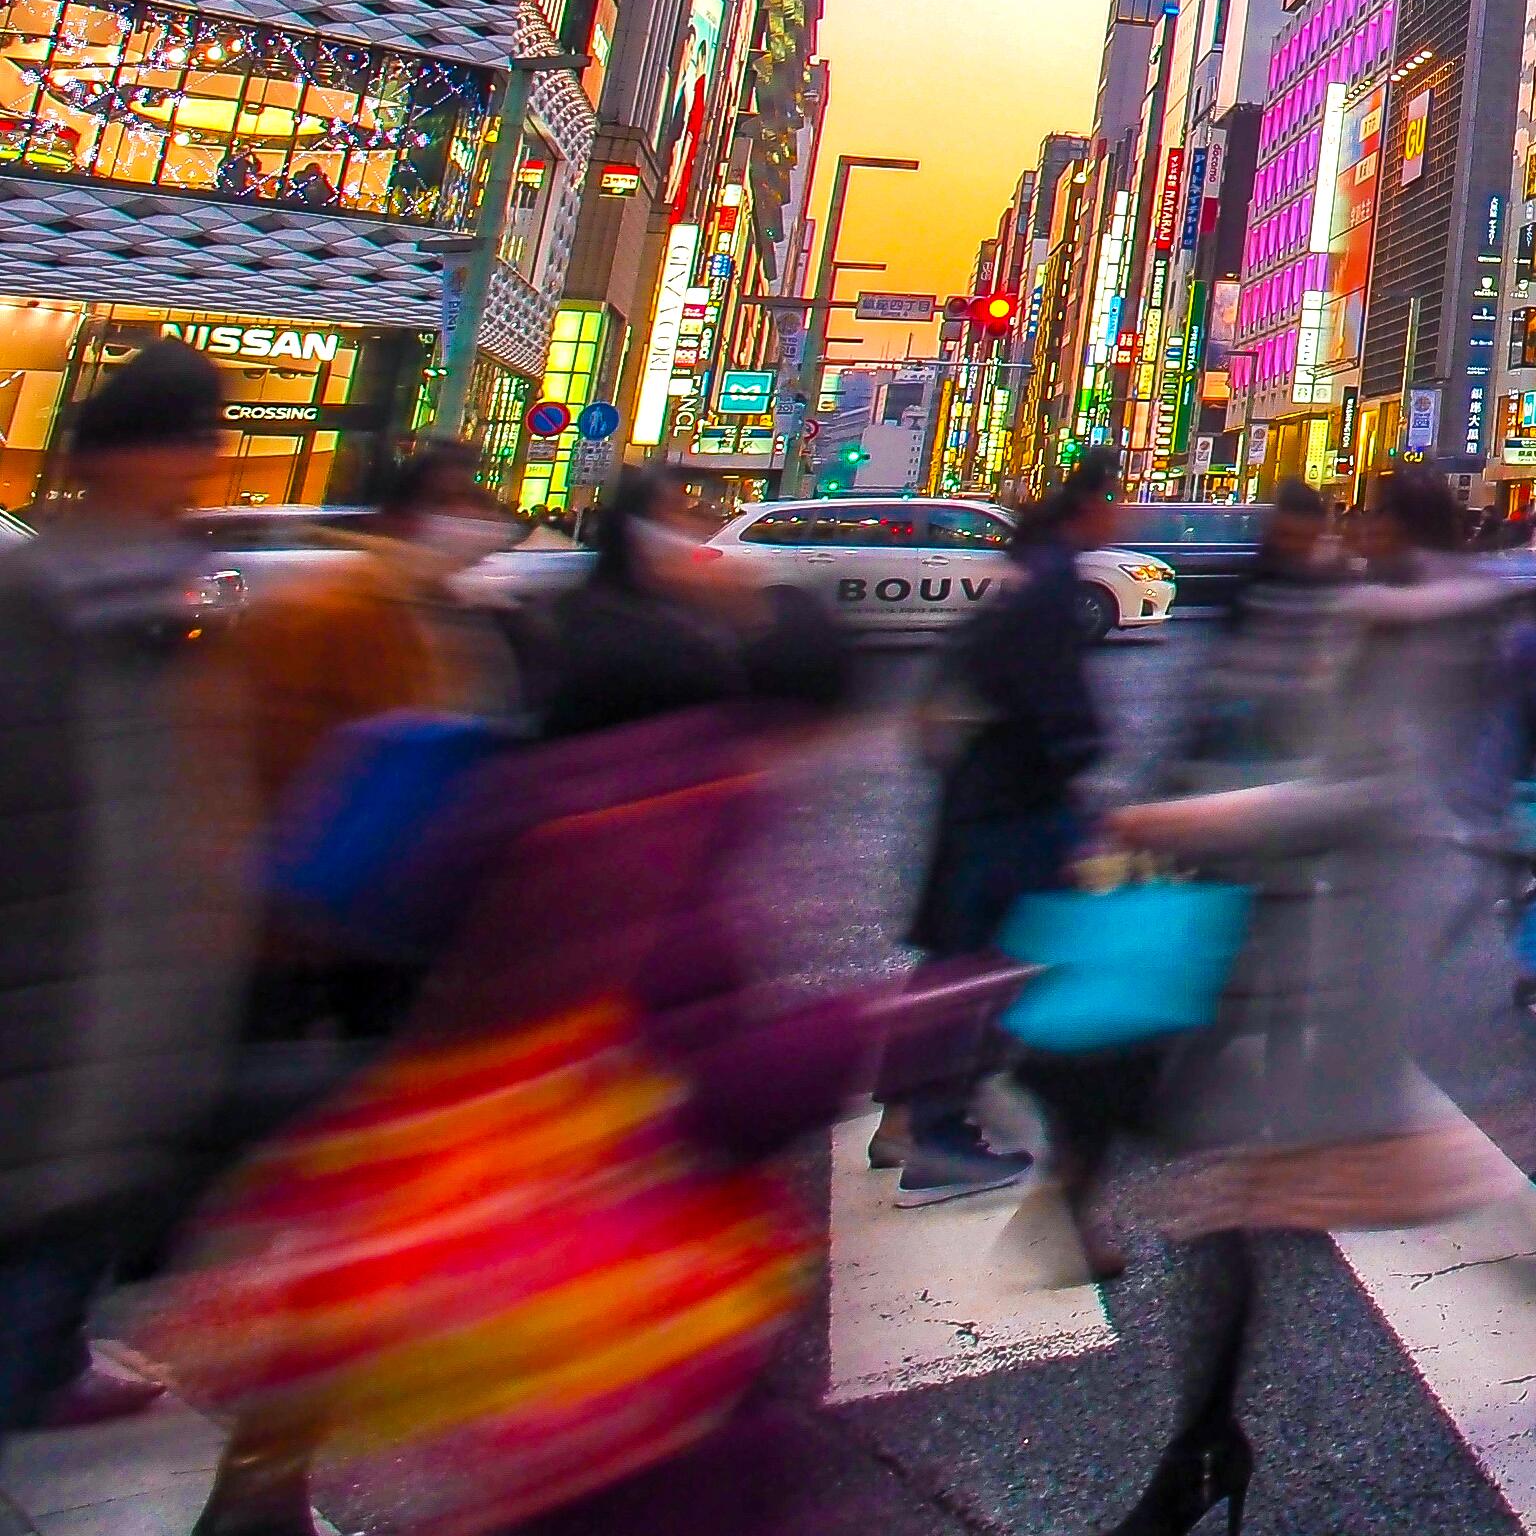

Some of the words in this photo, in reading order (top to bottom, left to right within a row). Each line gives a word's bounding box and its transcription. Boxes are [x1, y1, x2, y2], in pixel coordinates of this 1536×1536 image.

[1404, 116, 1427, 161] GU
[1208, 142, 1223, 184] docomo
[1158, 189, 1177, 242] NATARAJ
[160, 322, 339, 362] NISSAN
[224, 405, 319, 420] CROSSING
